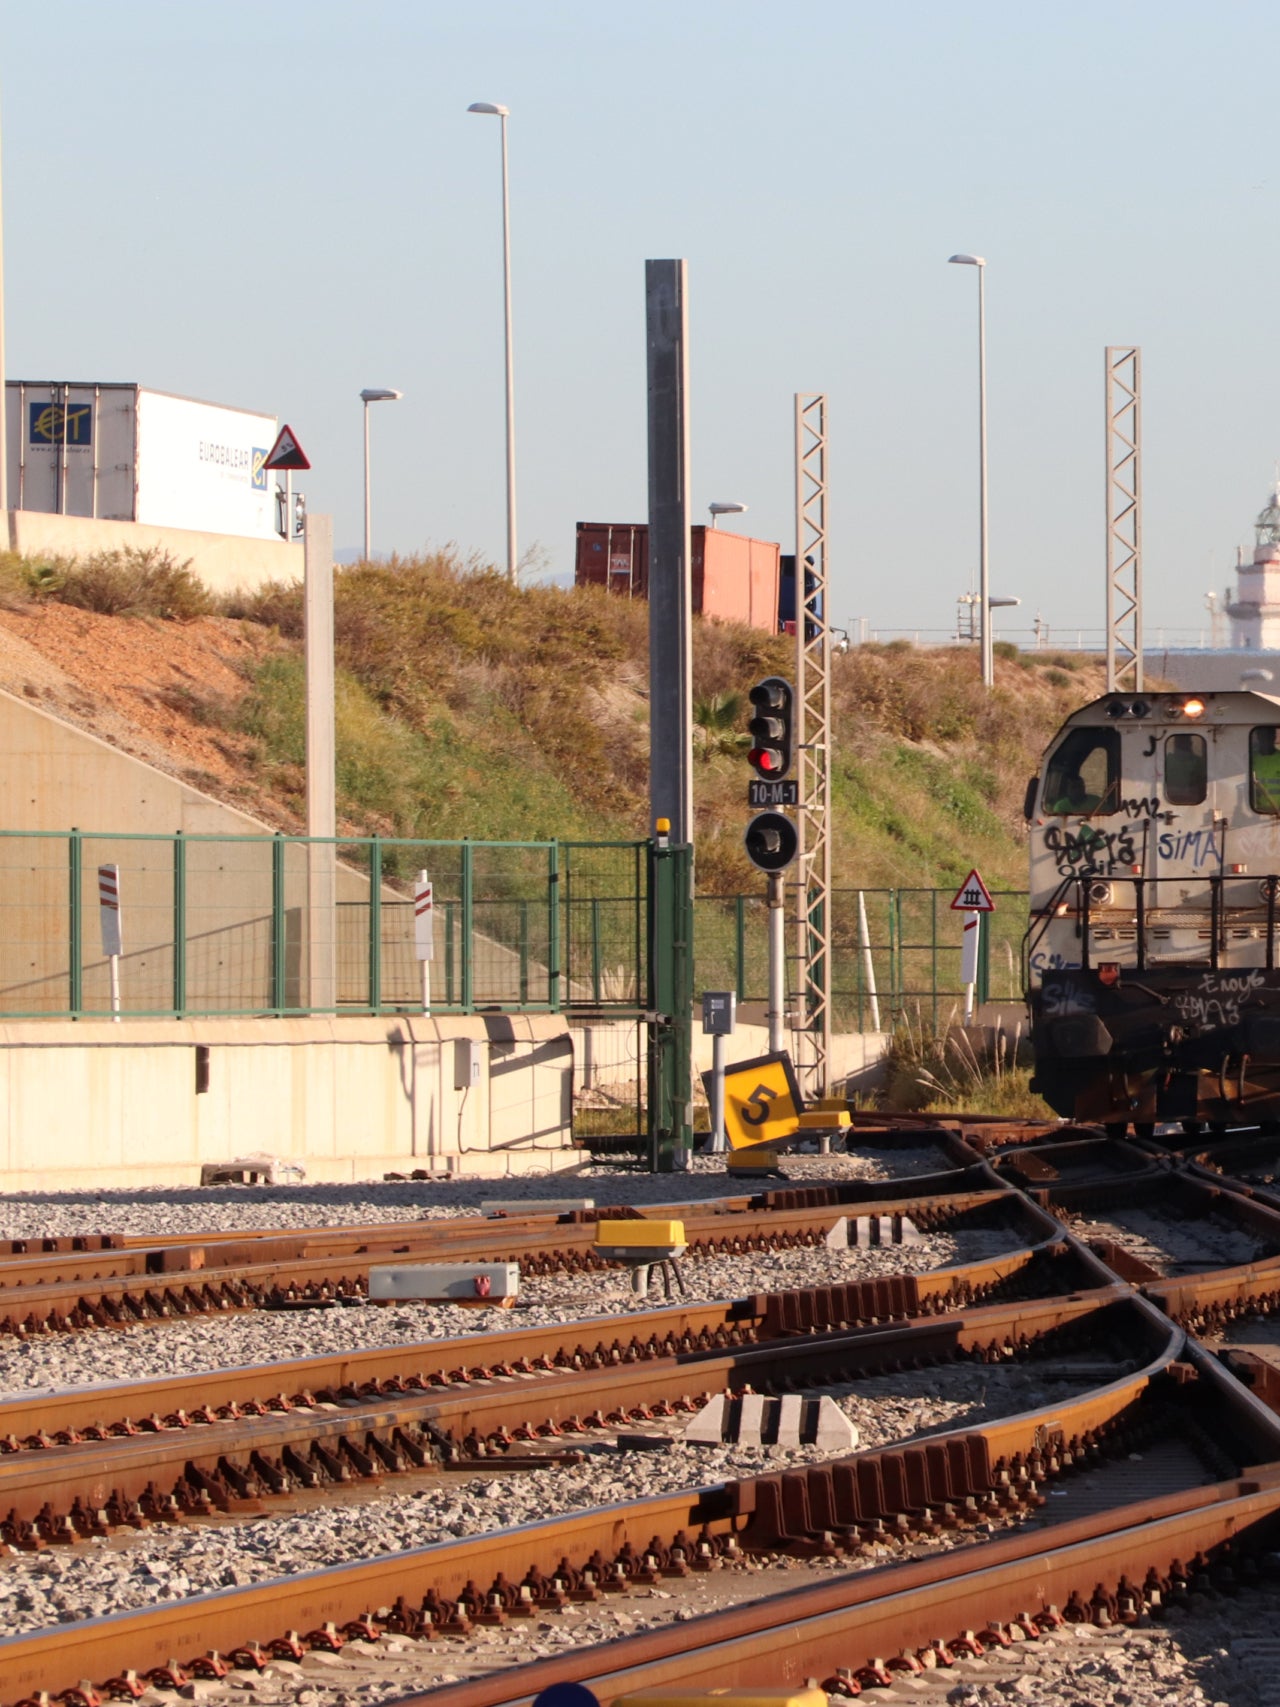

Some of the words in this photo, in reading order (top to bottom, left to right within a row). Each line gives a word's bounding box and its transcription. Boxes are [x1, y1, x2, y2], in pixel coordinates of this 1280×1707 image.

[199, 440, 249, 470] EUROBALEAR
[752, 783, 796, 803] 10-M-1
[741, 1083, 778, 1126] 5
